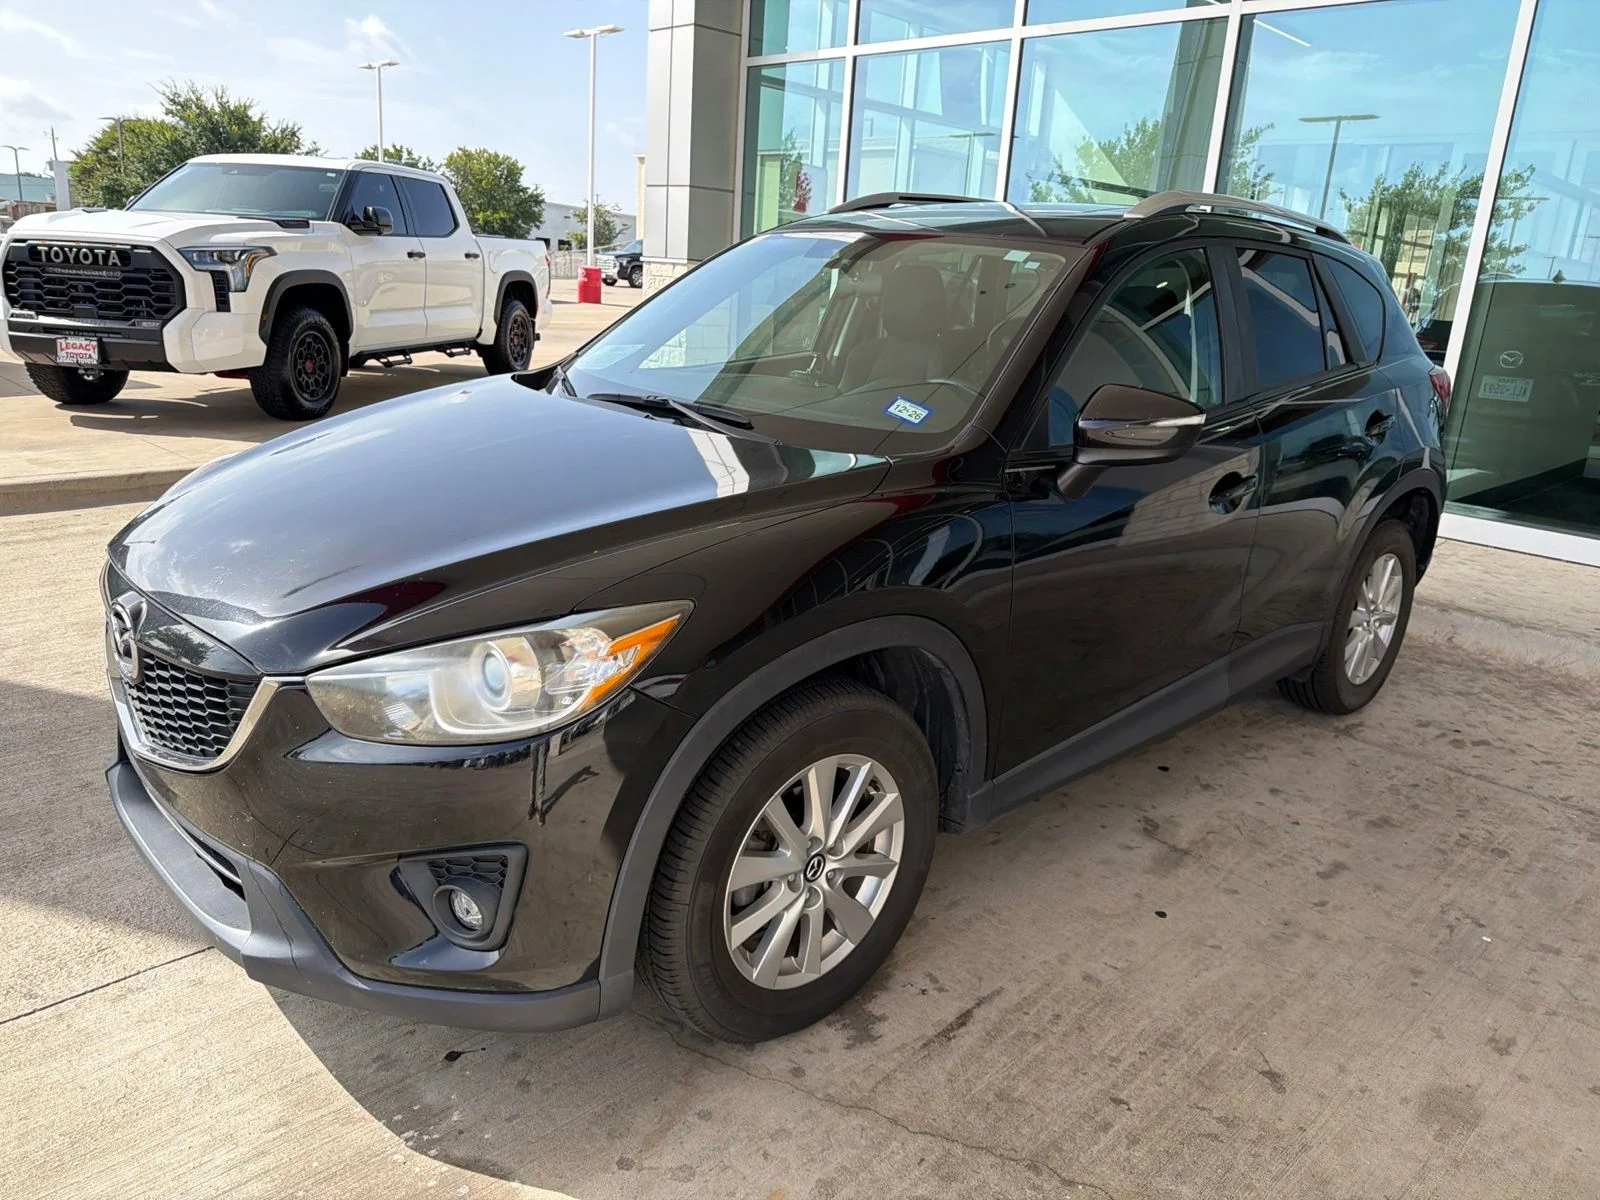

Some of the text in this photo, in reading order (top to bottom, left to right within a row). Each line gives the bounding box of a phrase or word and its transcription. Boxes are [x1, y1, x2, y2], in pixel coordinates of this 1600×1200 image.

[37, 246, 121, 266] TOYOTA
[60, 342, 97, 354] LEGACY
[65, 351, 93, 359] TOYOTA
